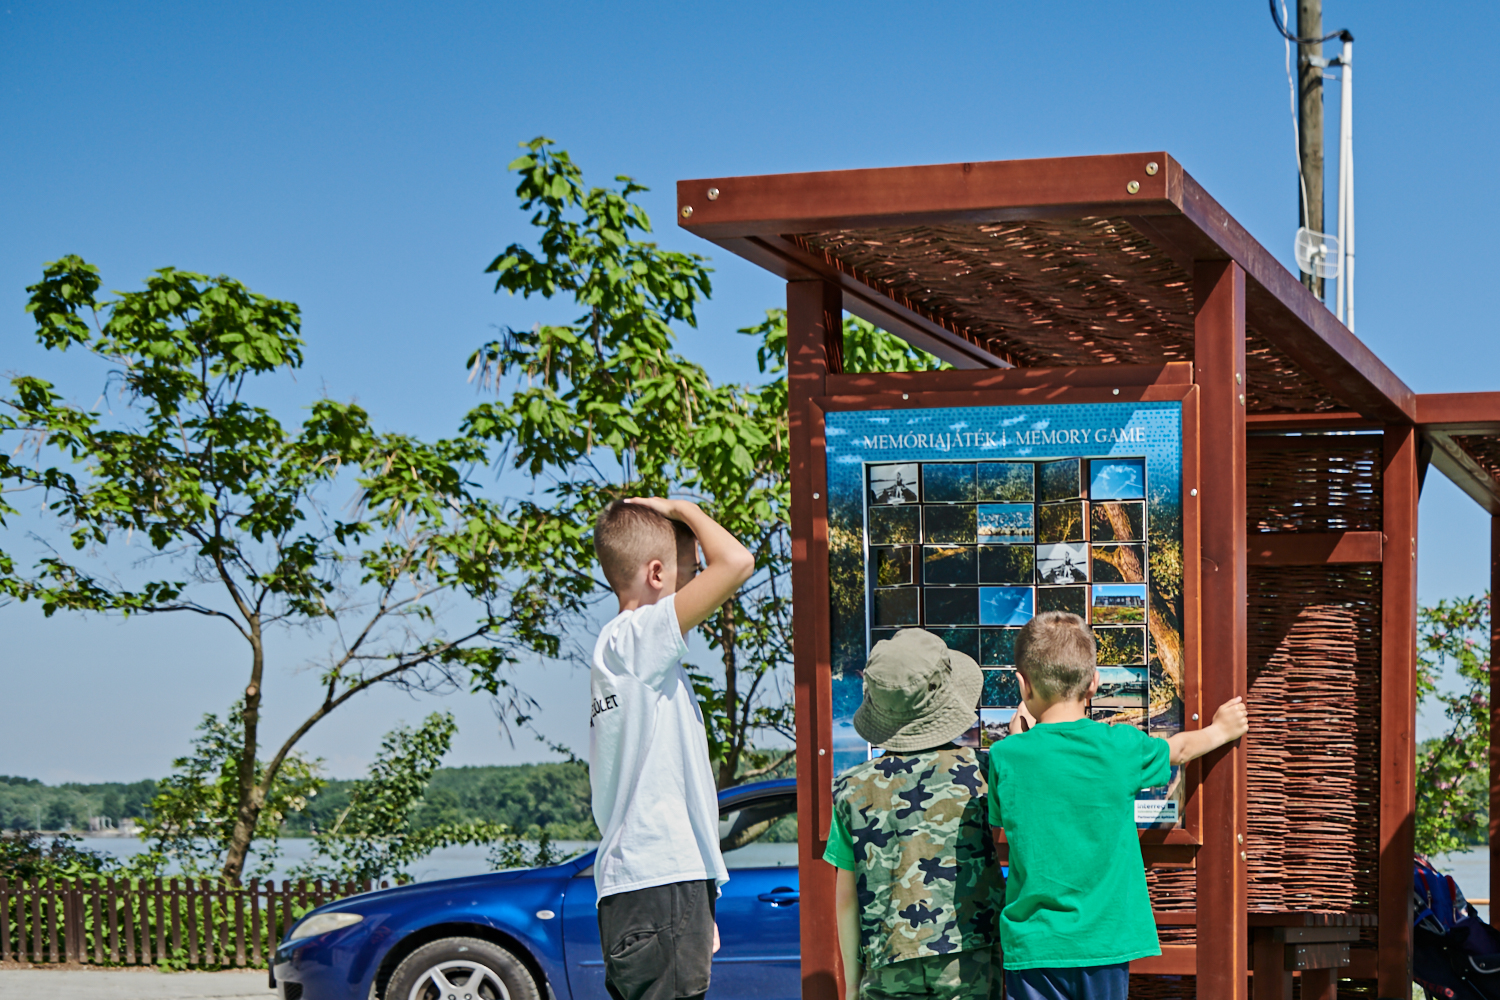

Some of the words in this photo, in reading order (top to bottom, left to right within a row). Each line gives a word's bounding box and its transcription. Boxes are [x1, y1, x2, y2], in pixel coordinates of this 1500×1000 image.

[864, 428, 996, 452] MEMÓRIAJÁTÉK
[1016, 428, 1093, 446] MEMORY
[1095, 427, 1146, 444] GAME
[591, 694, 618, 718] ÜLET
